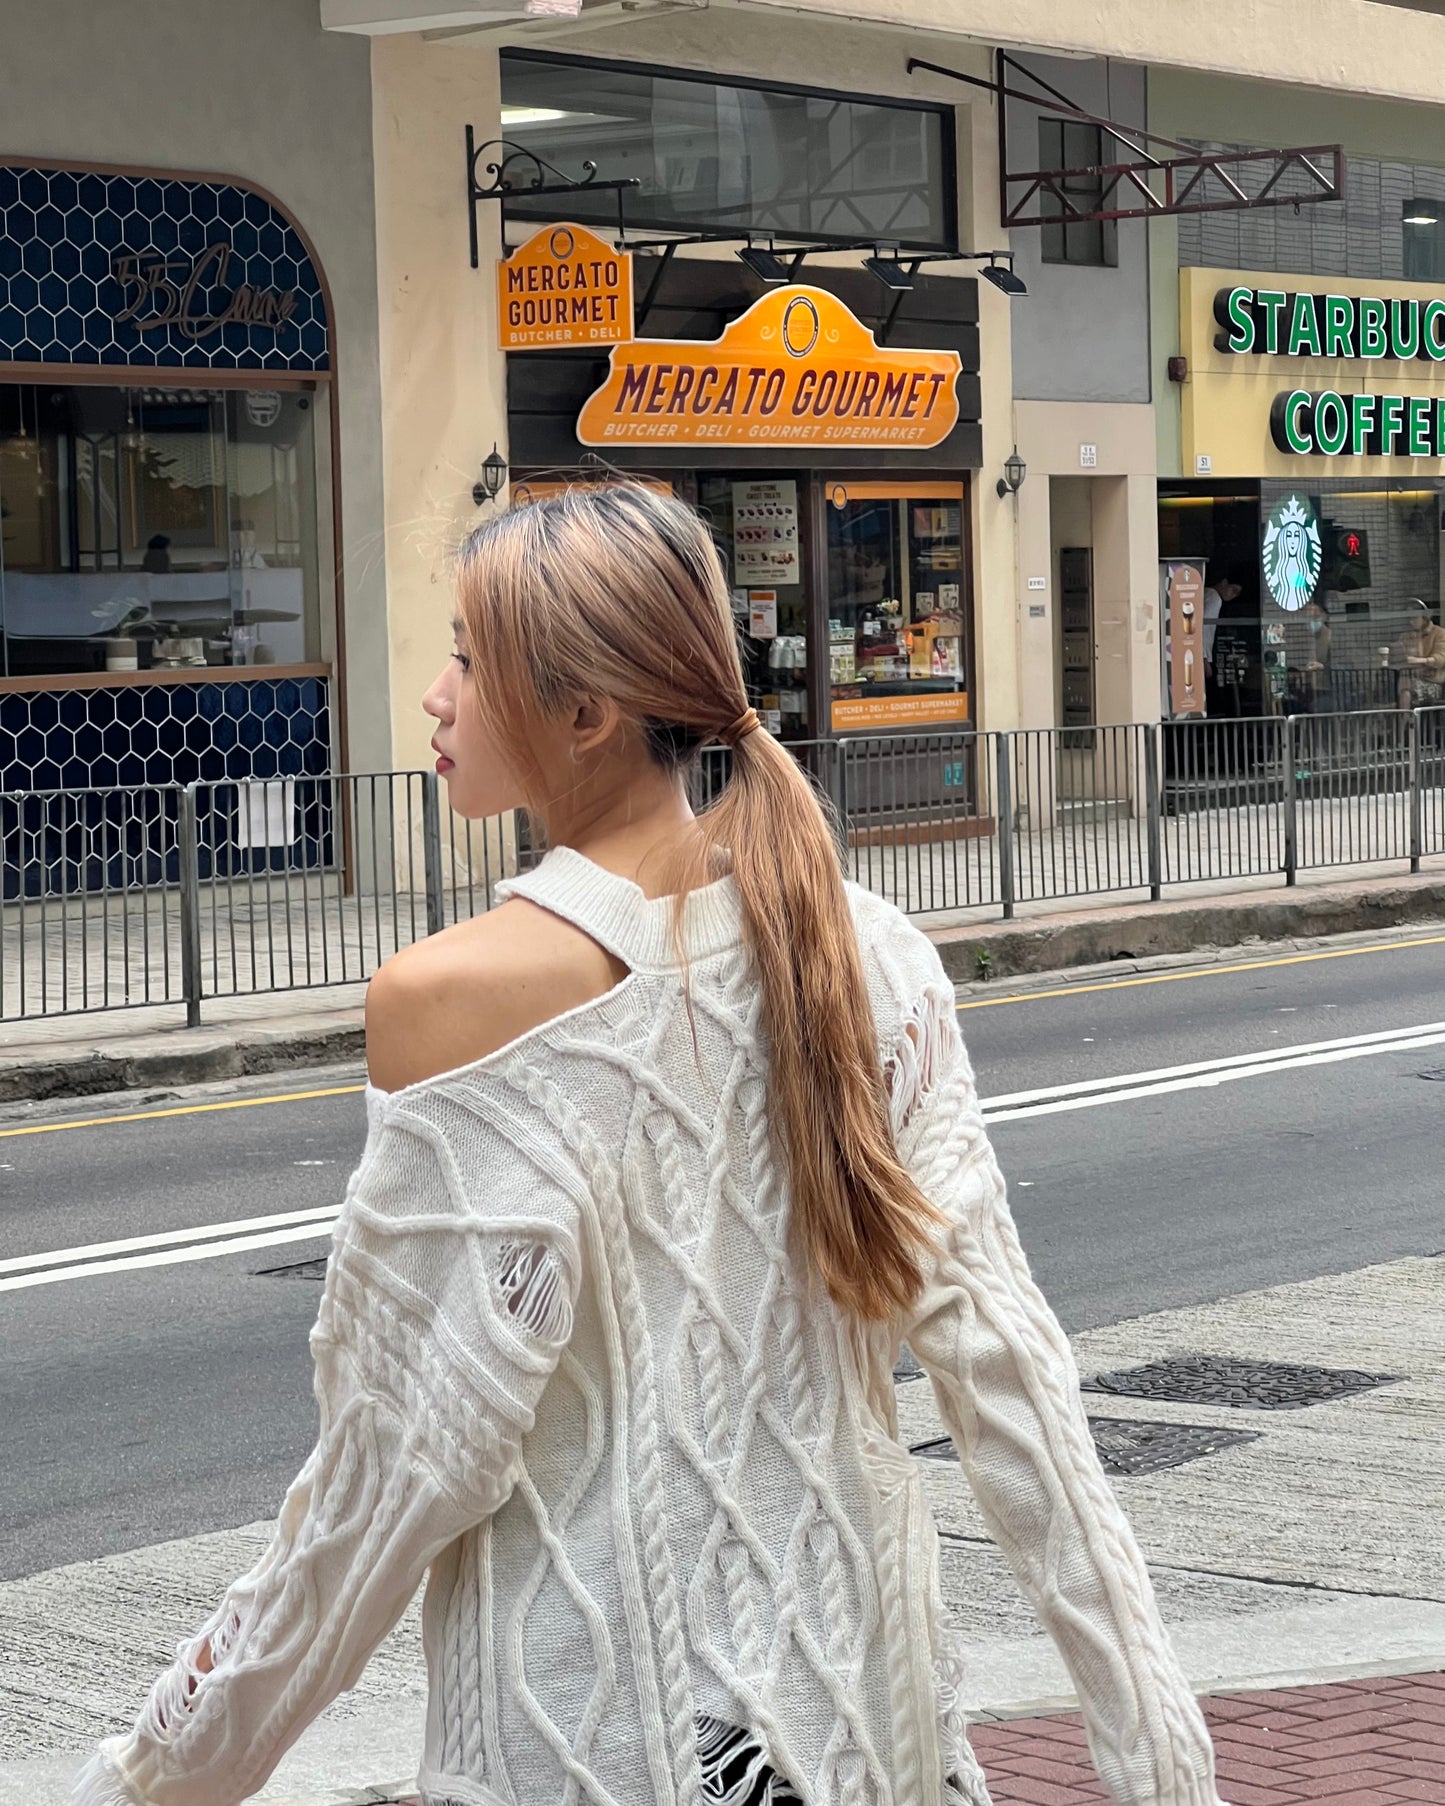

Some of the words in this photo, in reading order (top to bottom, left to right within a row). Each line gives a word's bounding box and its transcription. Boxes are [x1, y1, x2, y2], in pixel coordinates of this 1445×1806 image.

[508, 260, 619, 293] MERCATO
[508, 294, 619, 327] GOURMET
[509, 329, 573, 343] BUTCHER
[589, 326, 621, 339] DELI
[613, 363, 787, 416] MERCATO
[791, 369, 946, 419] GOURMET
[603, 423, 679, 437] BUTCHER
[695, 424, 732, 437] DELI
[748, 424, 821, 439] GOURMET
[823, 425, 926, 440] SUPERMARKET
